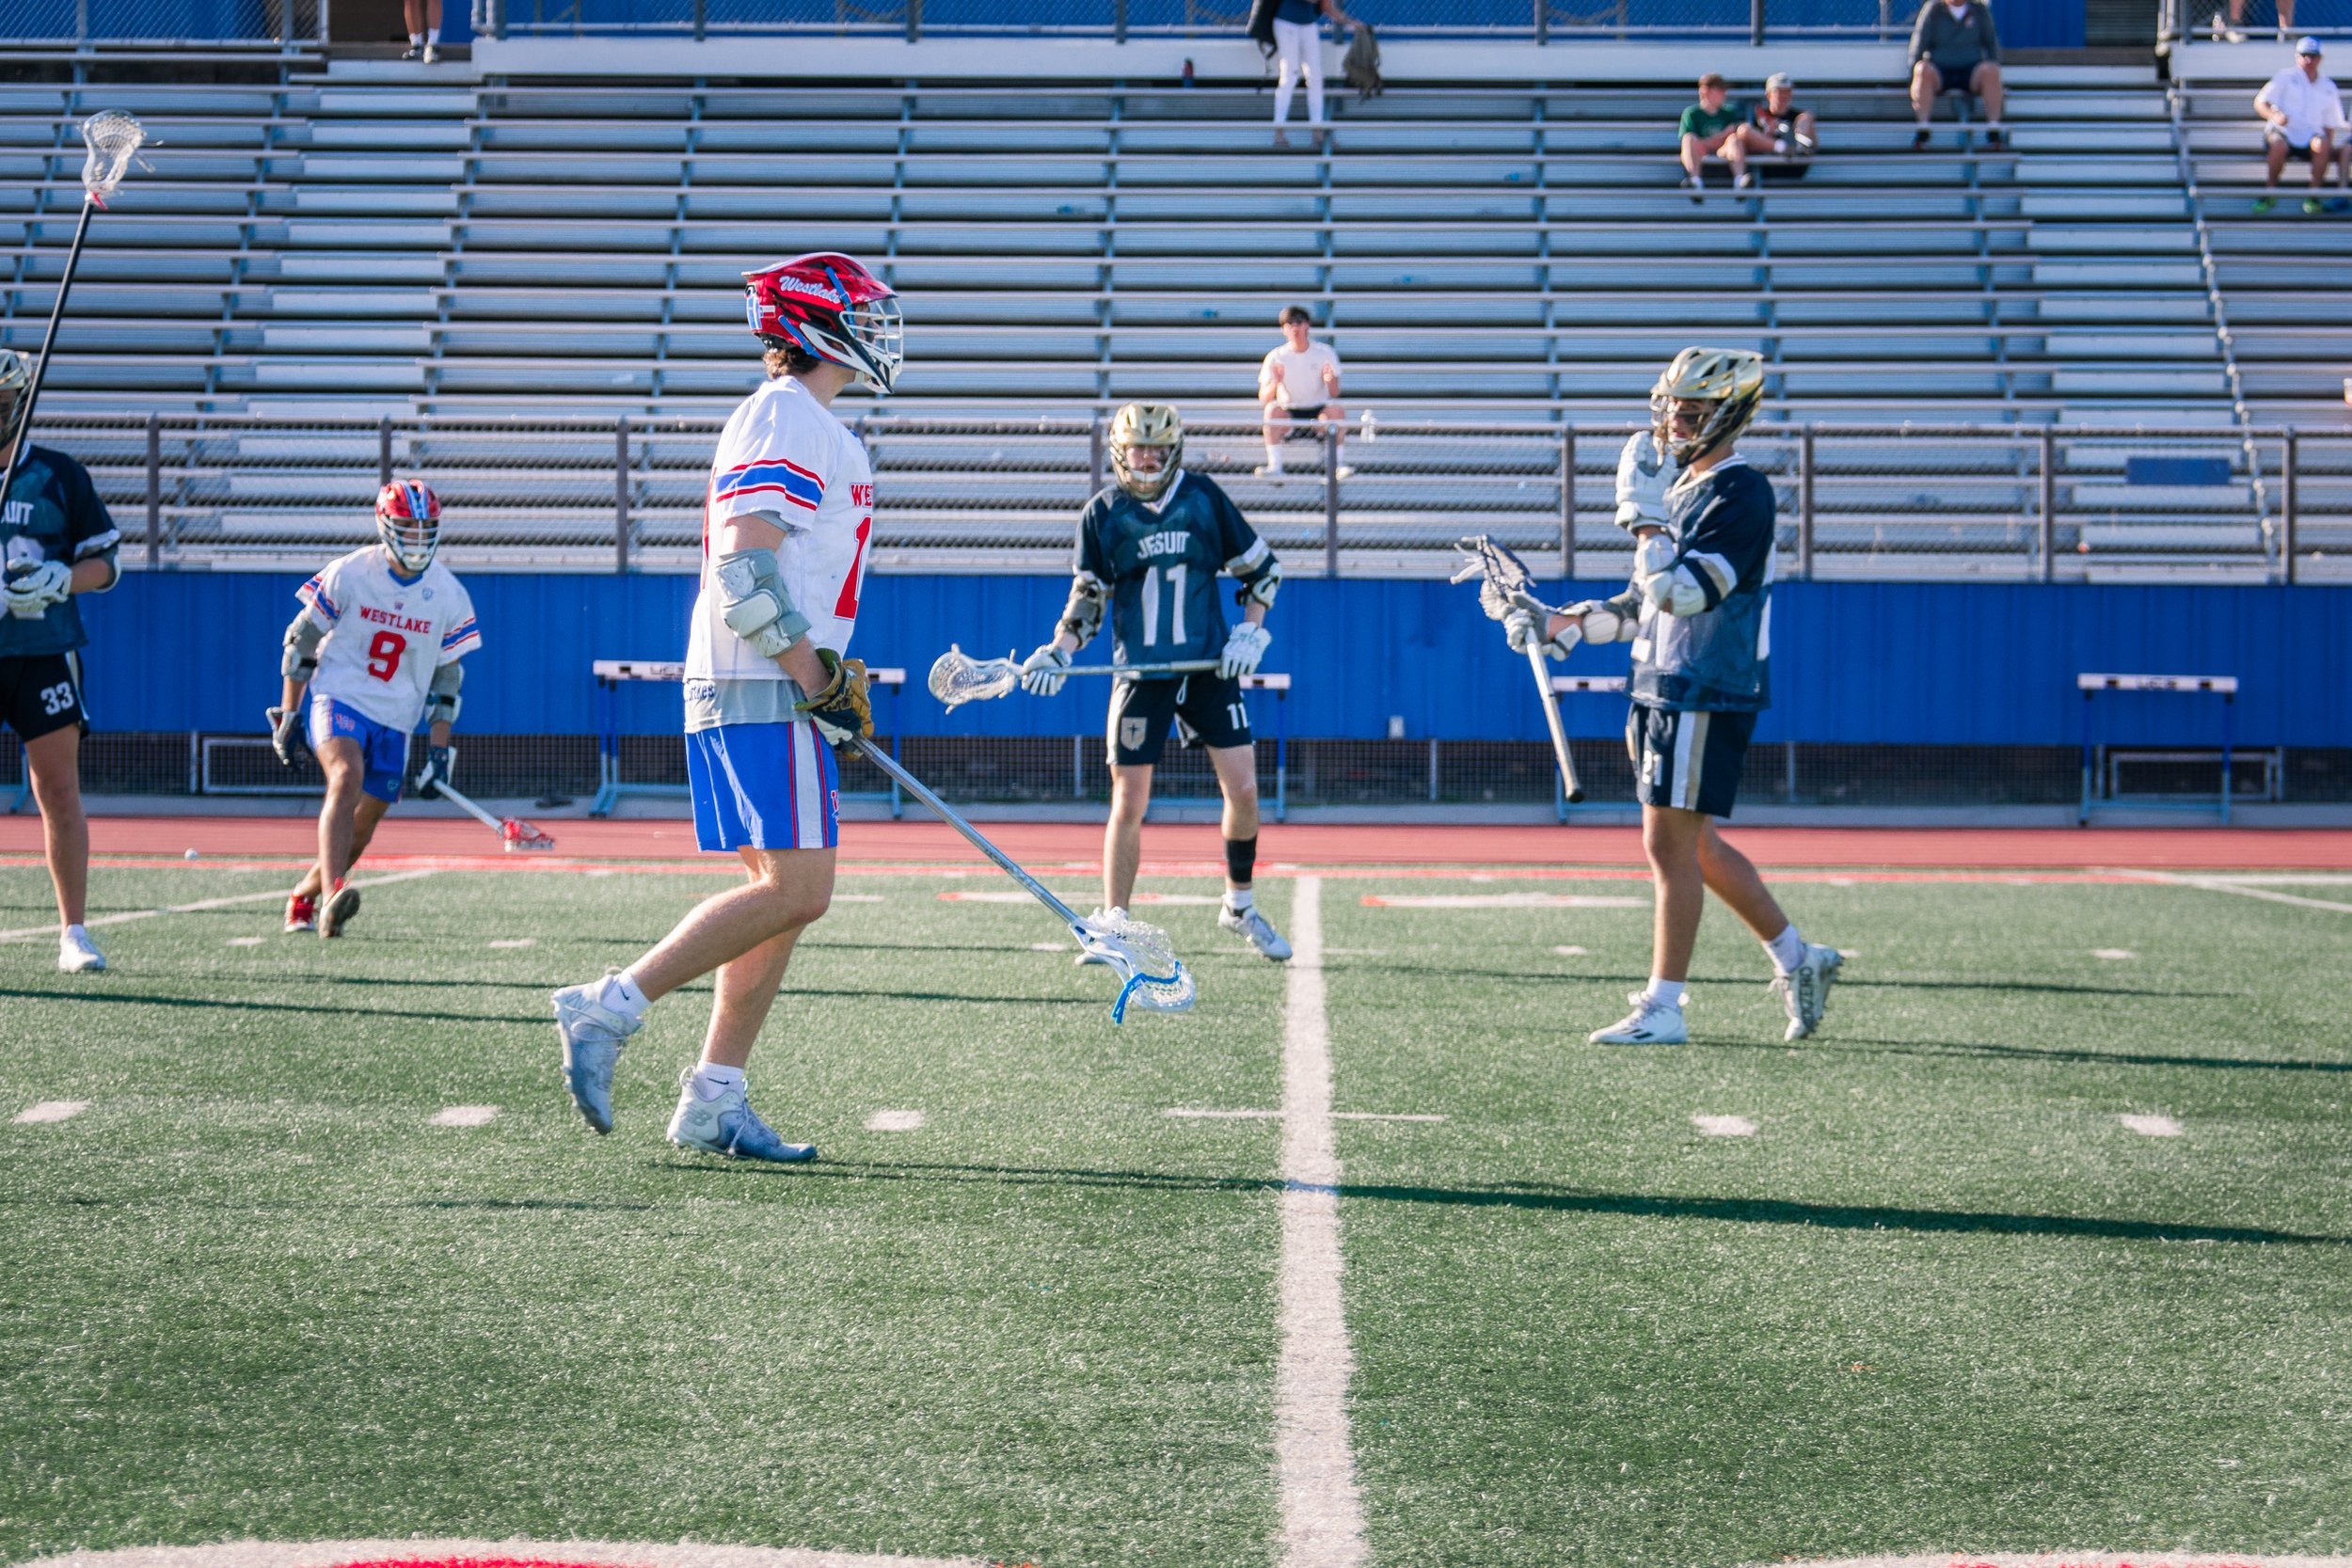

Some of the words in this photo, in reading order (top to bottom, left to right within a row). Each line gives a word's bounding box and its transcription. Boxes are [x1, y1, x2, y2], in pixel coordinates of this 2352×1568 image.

[780, 276, 842, 304] Westlak
[1, 499, 34, 525] UIT
[1136, 531, 1190, 559] JESUIT
[1141, 564, 1187, 646] 11
[359, 606, 432, 634] WESTLAKE
[368, 630, 406, 682] 9
[40, 681, 74, 717] 33
[1227, 703, 1248, 730] 11
